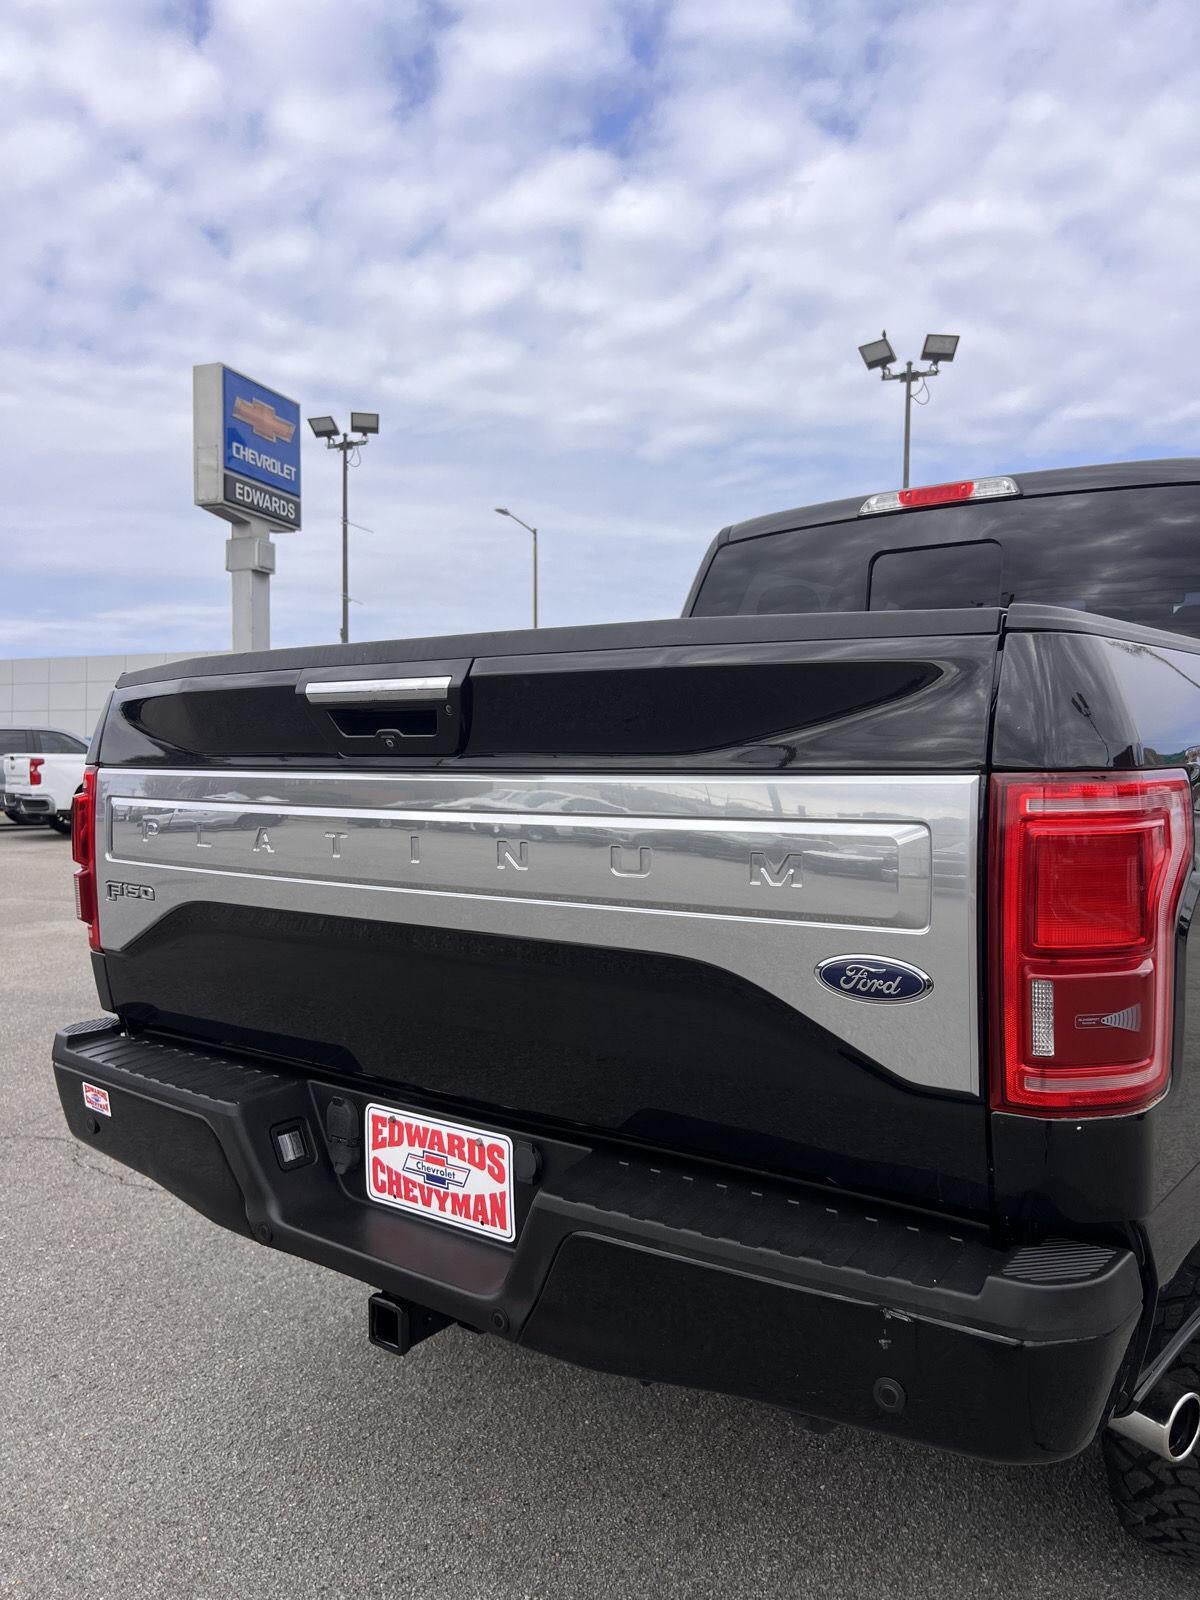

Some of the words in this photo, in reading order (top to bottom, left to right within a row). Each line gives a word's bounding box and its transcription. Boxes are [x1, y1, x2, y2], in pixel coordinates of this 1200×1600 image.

[232, 443, 296, 481] CHEVROLET
[235, 482, 295, 519] EDWARDS
[142, 815, 802, 887] PLATINUM
[840, 964, 902, 995] Ford
[371, 1114, 506, 1184] EDWARDS
[416, 1161, 456, 1179] Chevrolet
[372, 1156, 507, 1231] CHEVYMAN
